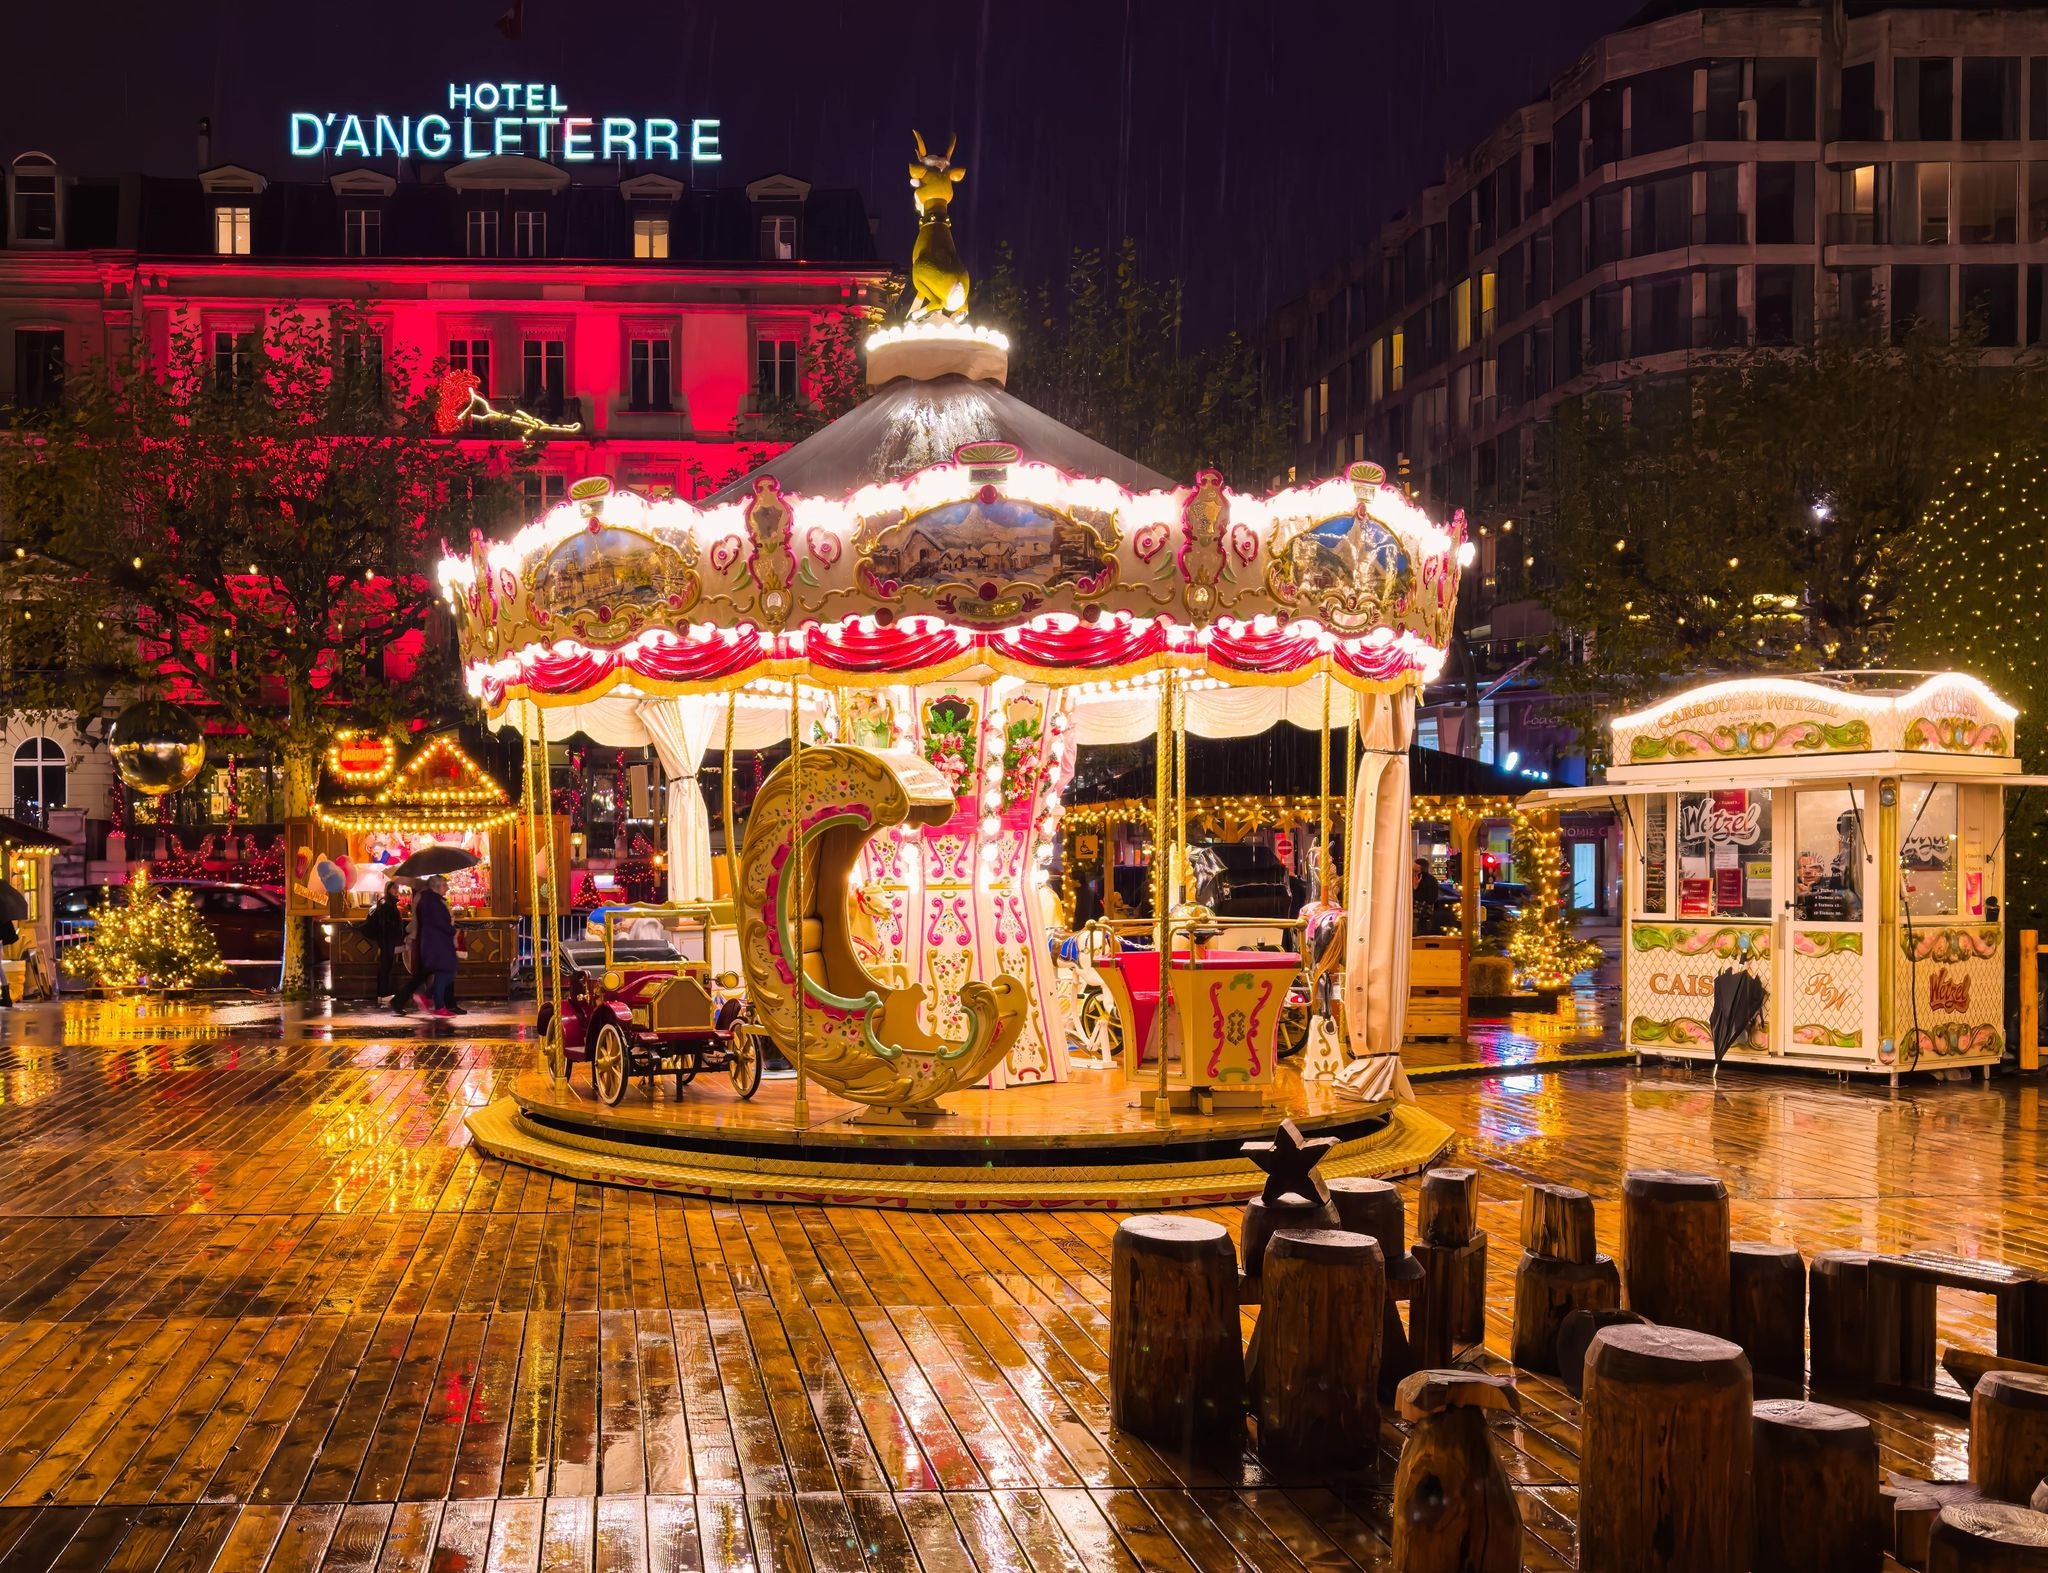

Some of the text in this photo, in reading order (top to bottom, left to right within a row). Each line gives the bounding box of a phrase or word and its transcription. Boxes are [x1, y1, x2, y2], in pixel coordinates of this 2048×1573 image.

[448, 82, 568, 112] HOTEL
[290, 112, 723, 161] D'ANGLETERRE
[1766, 695, 1840, 718] WETZEL
[1683, 798, 1760, 845] Wetzel
[1649, 973, 1714, 998] CAIS
[1929, 967, 1971, 1014] Wetzel
